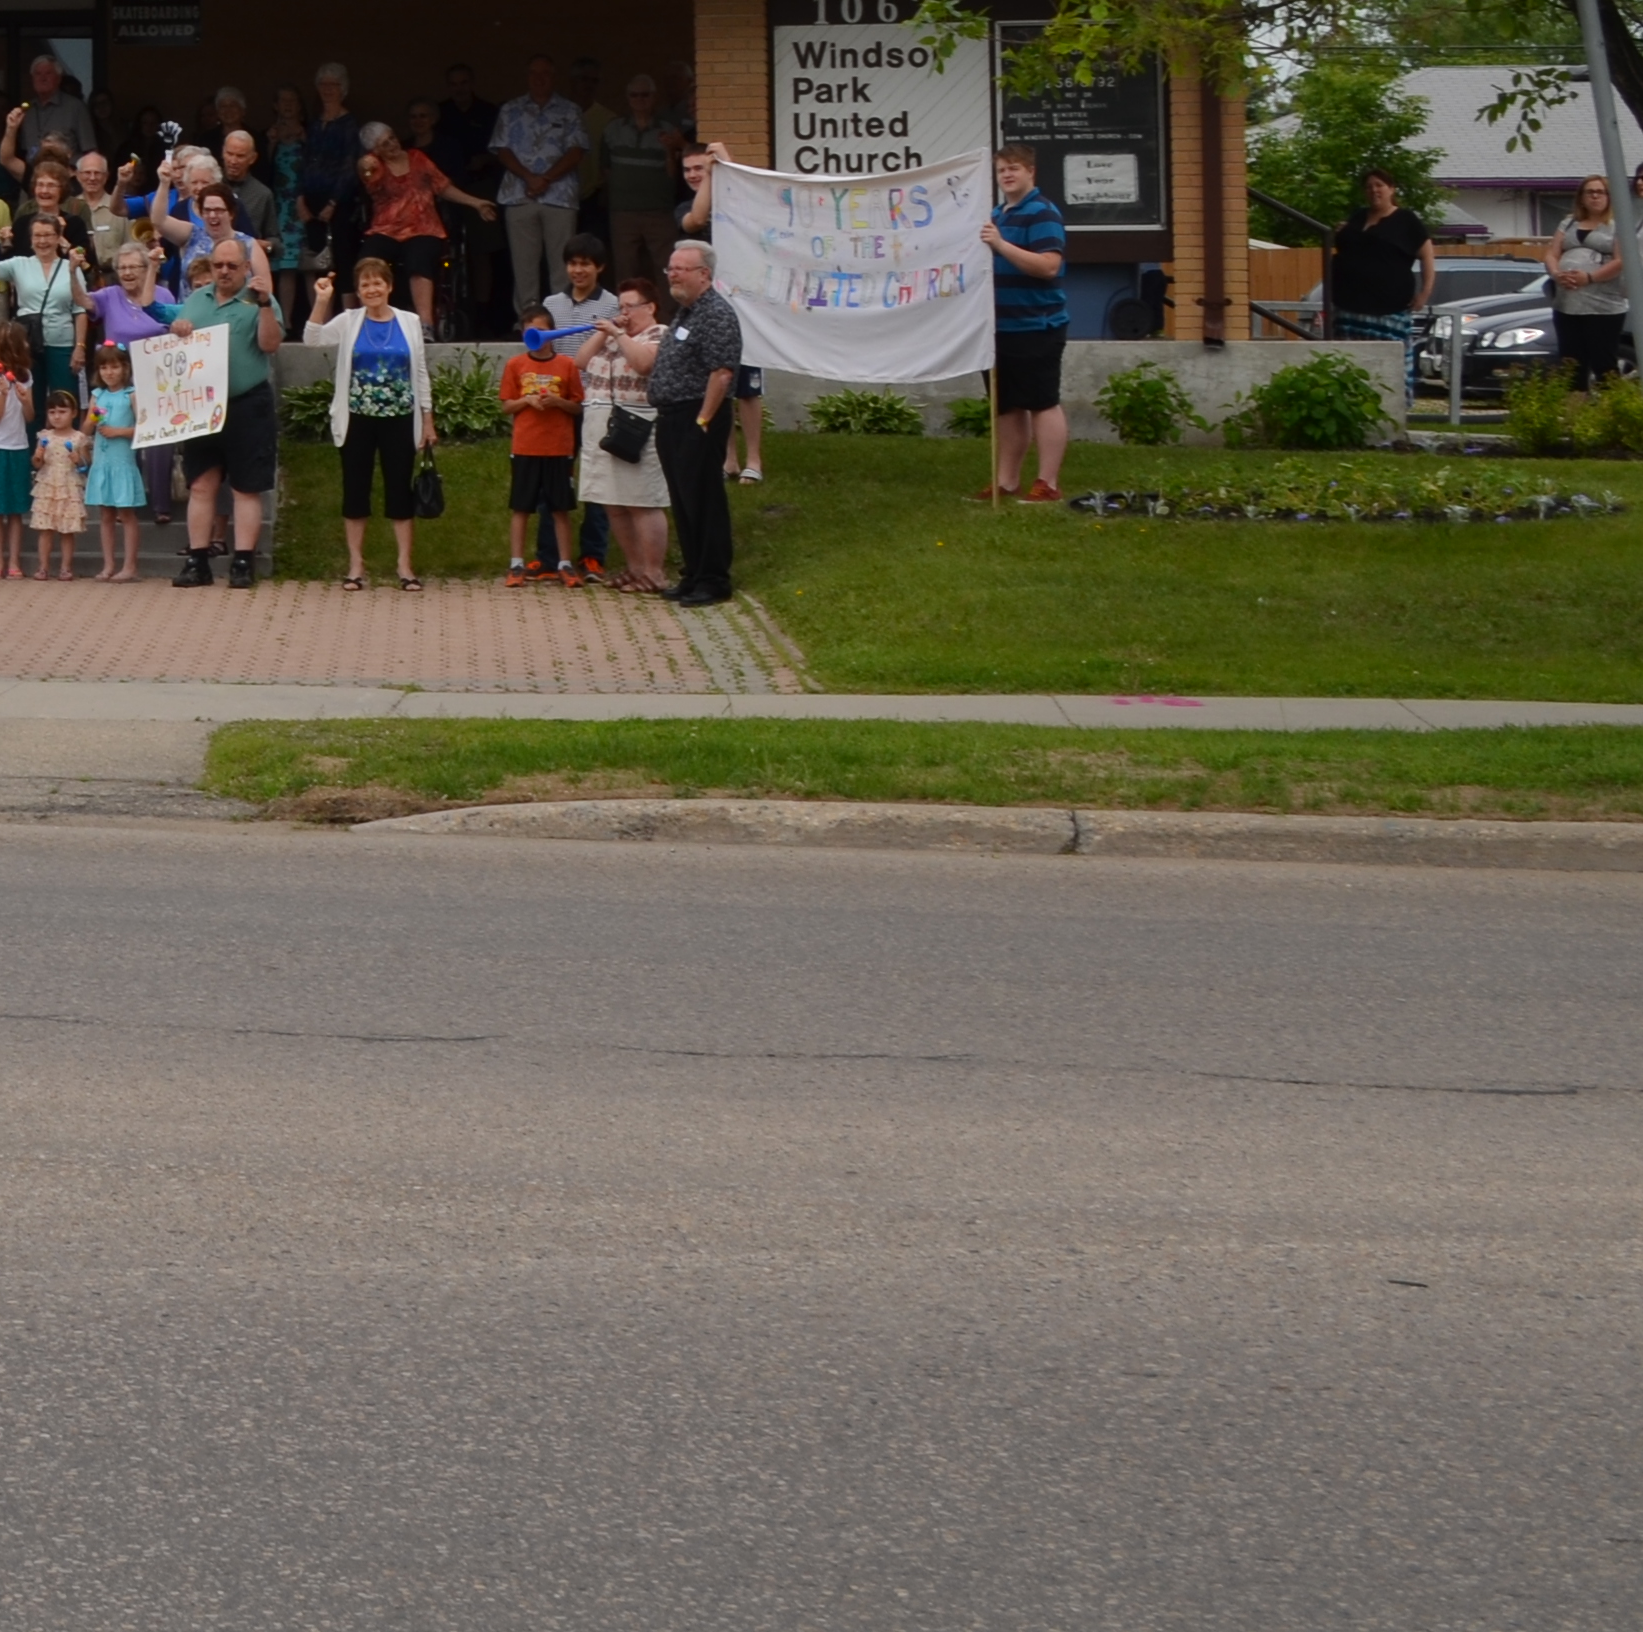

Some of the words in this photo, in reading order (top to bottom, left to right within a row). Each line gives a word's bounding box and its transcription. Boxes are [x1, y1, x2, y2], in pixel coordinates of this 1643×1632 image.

[112, 5, 200, 20] SKATEBOARDING
[117, 24, 195, 37] ALLOWED
[793, 40, 936, 70] Windso
[793, 76, 872, 104] Park
[793, 111, 909, 140] United
[794, 146, 923, 174] Church
[1086, 160, 1113, 169] Love
[1086, 176, 1115, 185] Your
[829, 185, 933, 230] YEARS
[1071, 192, 1132, 202] Neighbour
[811, 235, 834, 260] OF
[850, 235, 885, 260] THE
[765, 264, 878, 308] UNITED
[882, 263, 965, 308] CHURCH
[164, 351, 187, 378] 90
[158, 385, 204, 417] FAITH
